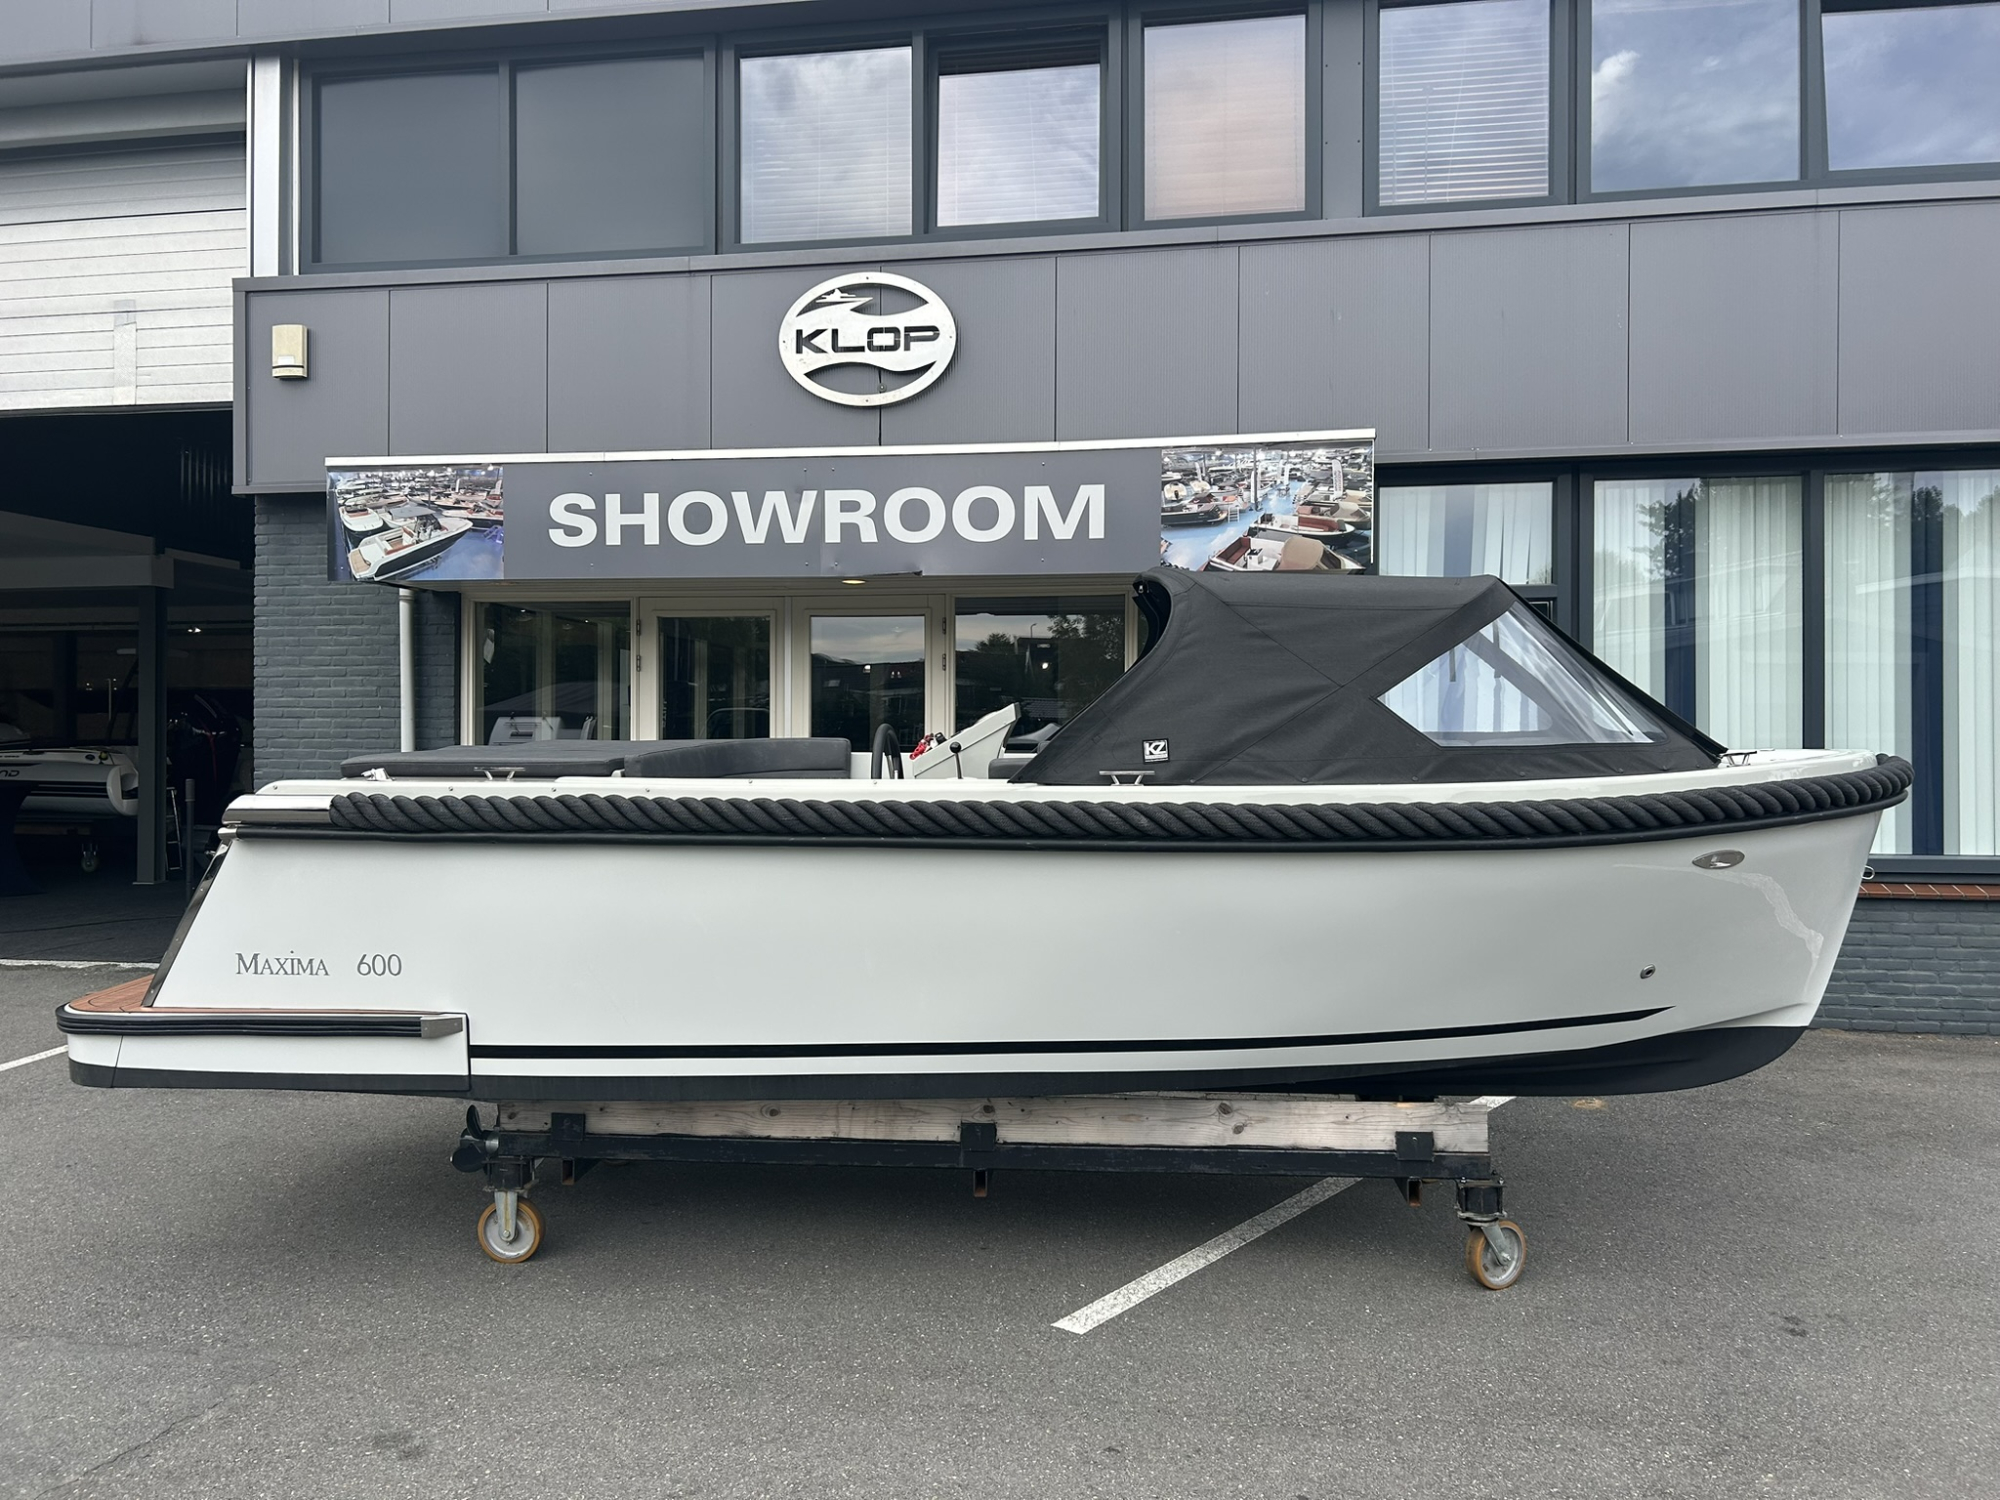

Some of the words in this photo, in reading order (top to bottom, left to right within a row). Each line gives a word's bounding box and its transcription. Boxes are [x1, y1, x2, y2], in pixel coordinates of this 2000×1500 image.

[795, 325, 941, 355] KLOP
[547, 483, 1106, 548] SHOWROOM
[235, 950, 330, 977] MAXIMA
[356, 953, 403, 977] 600
